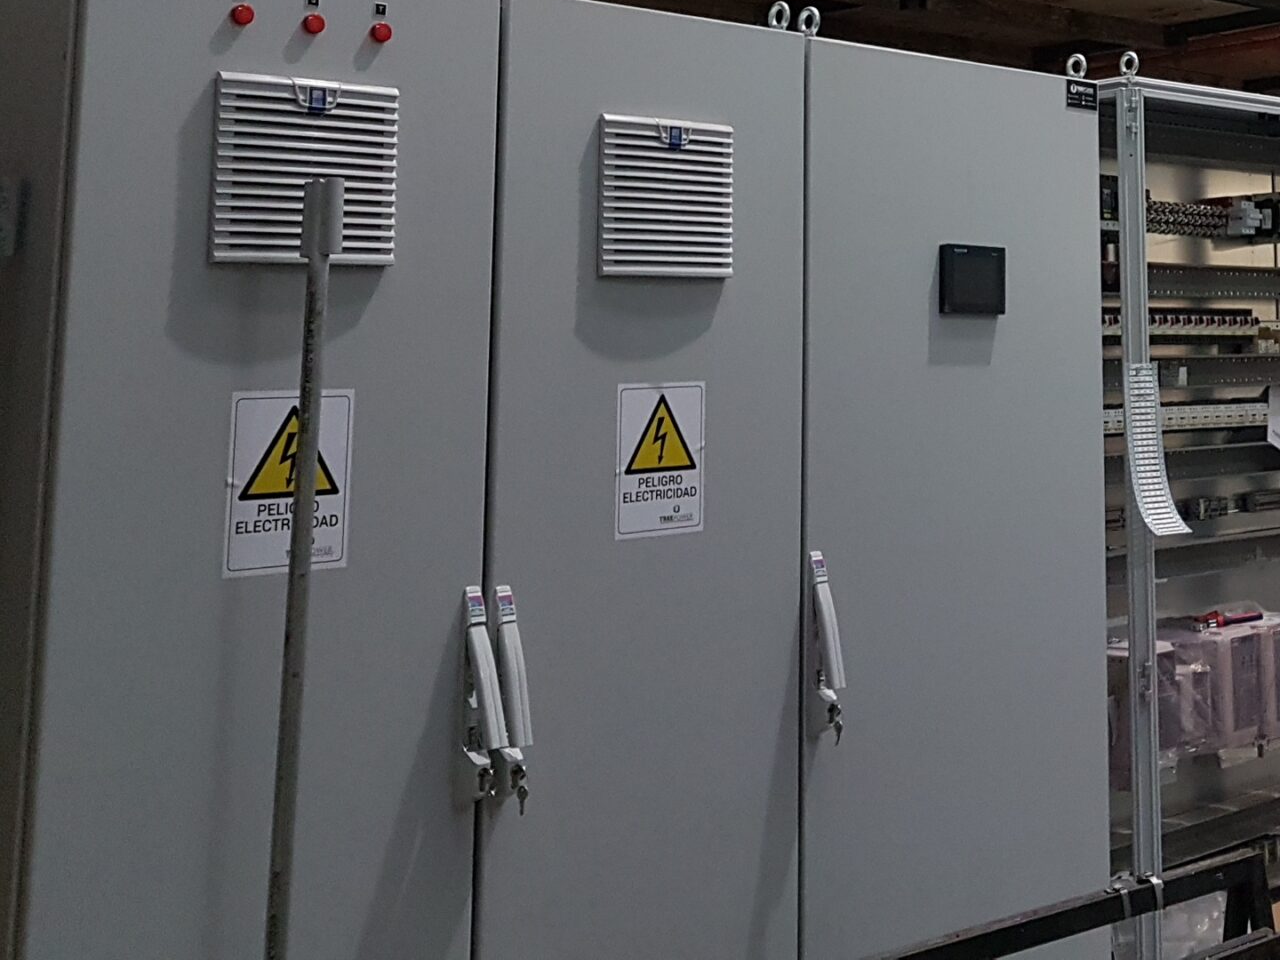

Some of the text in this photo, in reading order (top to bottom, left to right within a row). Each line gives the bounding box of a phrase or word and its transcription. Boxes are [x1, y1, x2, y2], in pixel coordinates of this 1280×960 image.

[638, 474, 682, 489] PELIGRO
[622, 486, 697, 504] ELECTRICIDAD
[257, 500, 320, 518] PELIO
[235, 514, 339, 535] ELECTRDAD
